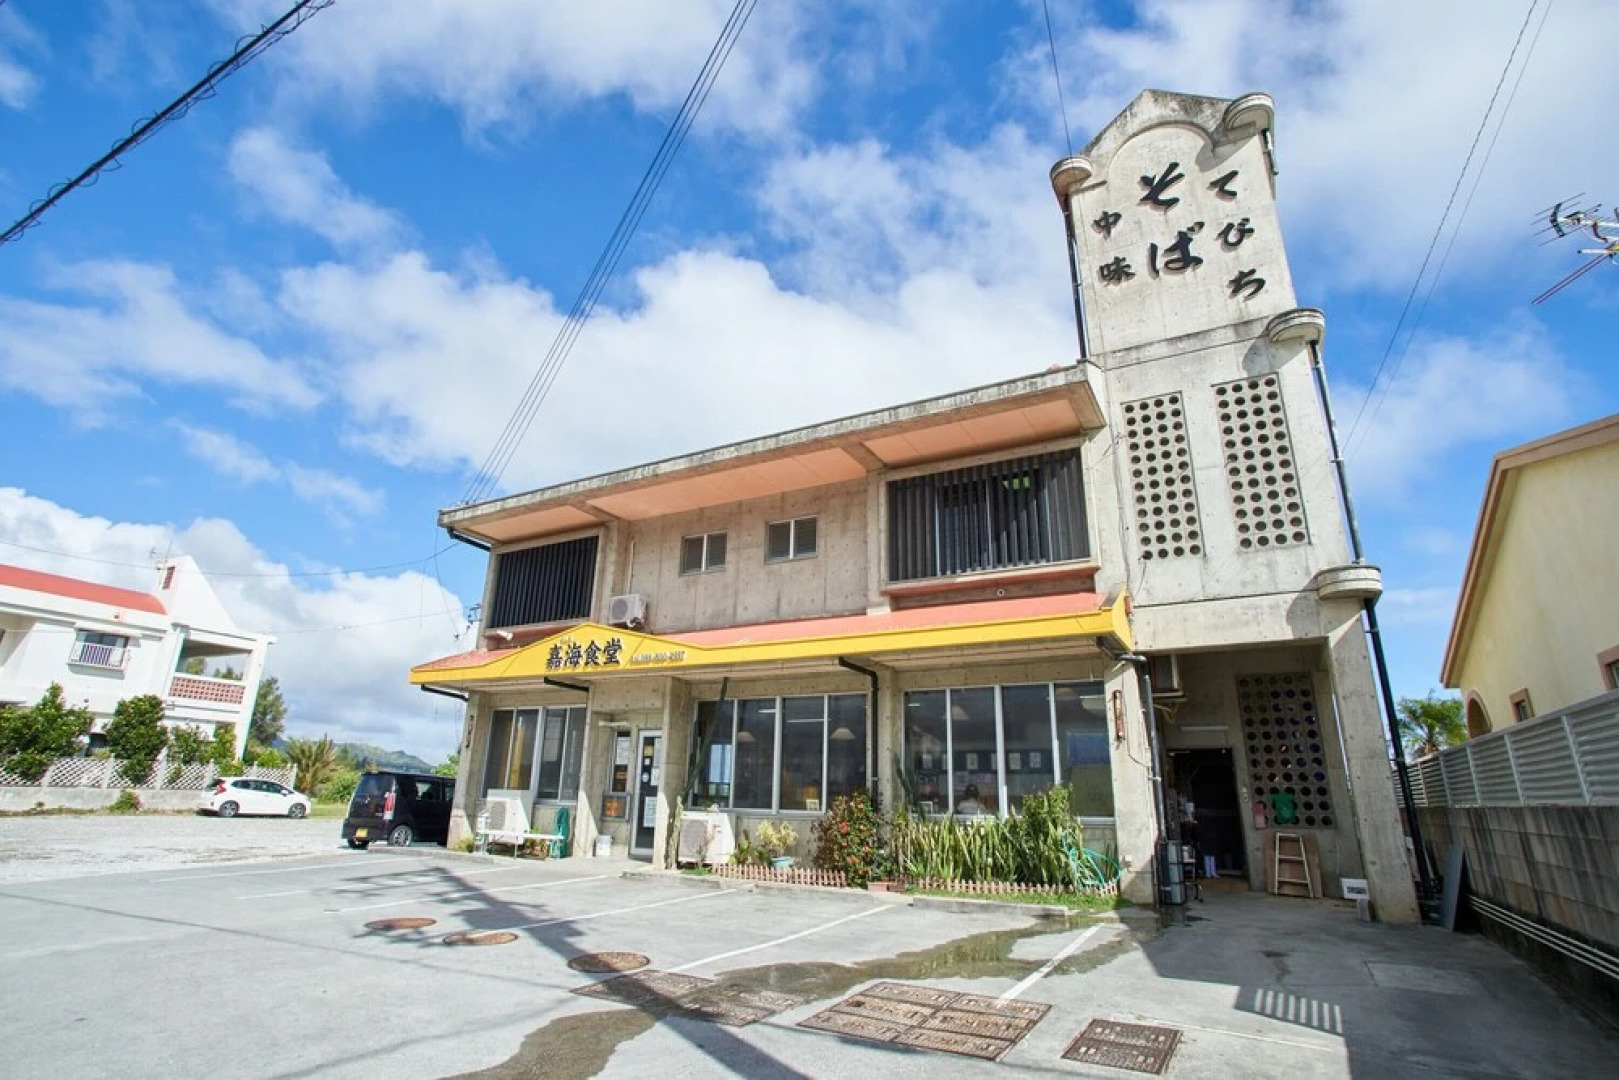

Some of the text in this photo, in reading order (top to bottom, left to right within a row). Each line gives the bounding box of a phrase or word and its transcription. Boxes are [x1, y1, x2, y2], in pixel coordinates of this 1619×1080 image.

[1093, 211, 1136, 284] 中味
[1140, 161, 1205, 276] そば
[1208, 169, 1266, 301] てびち
[546, 637, 622, 670] 嘉海食堂
